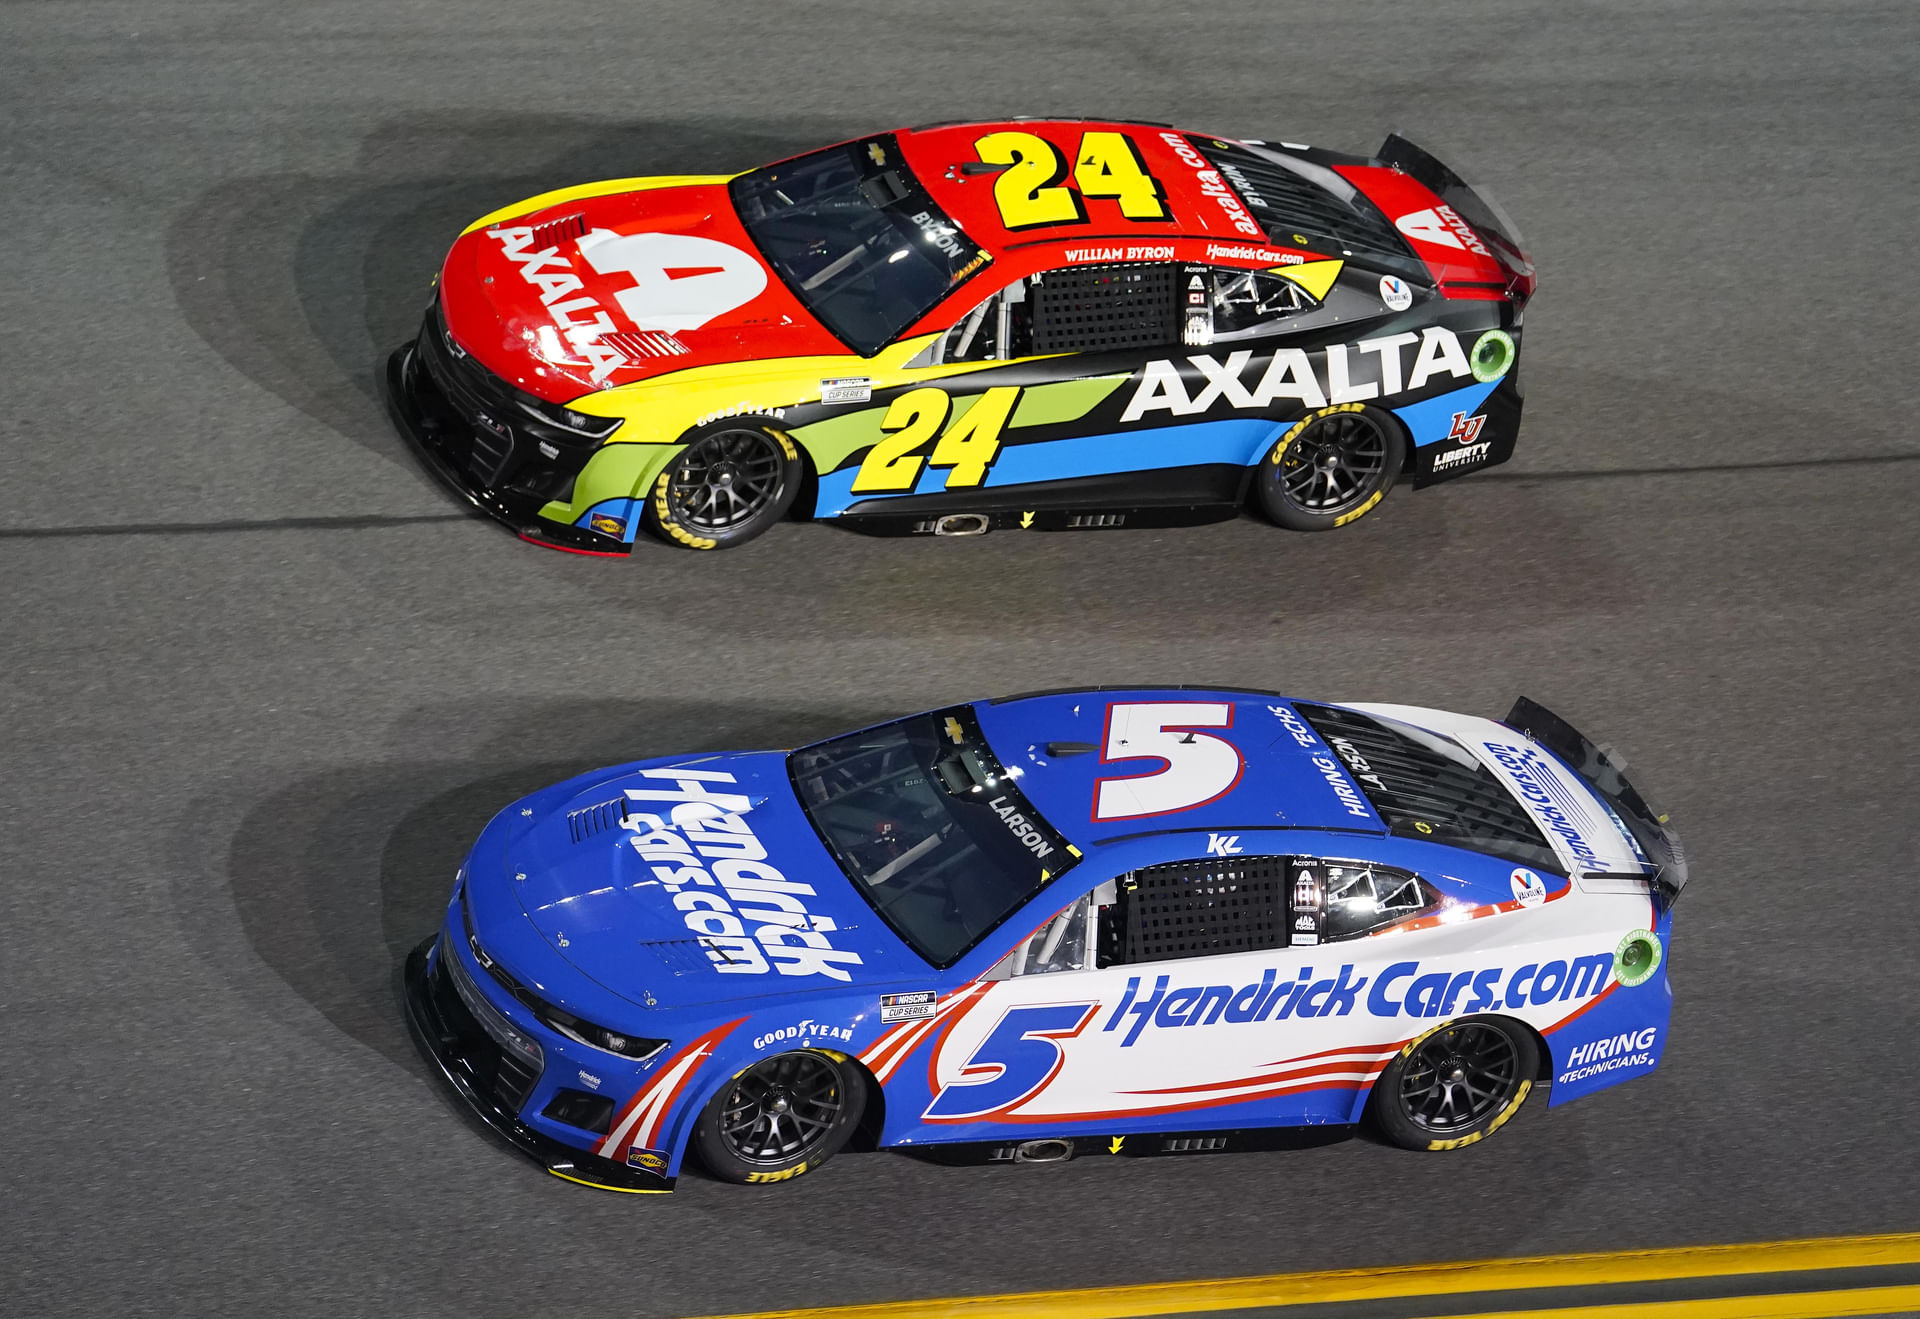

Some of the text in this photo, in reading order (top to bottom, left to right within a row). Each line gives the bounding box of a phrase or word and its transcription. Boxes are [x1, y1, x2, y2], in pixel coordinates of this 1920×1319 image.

[974, 132, 1173, 231] 24
[912, 211, 964, 258] BYRON
[1435, 205, 1492, 257] AXALTA
[1065, 247, 1175, 262] WILLIAM BYRON
[486, 226, 628, 385] AXALTA
[828, 390, 864, 399] CUP SERIES
[1119, 327, 1472, 422] AXALTA
[850, 387, 1024, 494] 24
[1434, 442, 1491, 466] LIBERTY
[1432, 453, 1489, 473] UNIVERSITY
[1091, 701, 1245, 822] 5
[1312, 757, 1370, 818] HIRING
[988, 795, 1055, 859] LARSON
[1292, 859, 1318, 867] Acronis
[1516, 886, 1544, 900] VALVOLINE
[888, 1005, 929, 1017] CUP SERIES
[898, 993, 929, 1005] NASCAR
[920, 1000, 1101, 1121] 5
[1566, 1027, 1657, 1069] HIRING
[631, 1153, 668, 1170] SUNOCO
